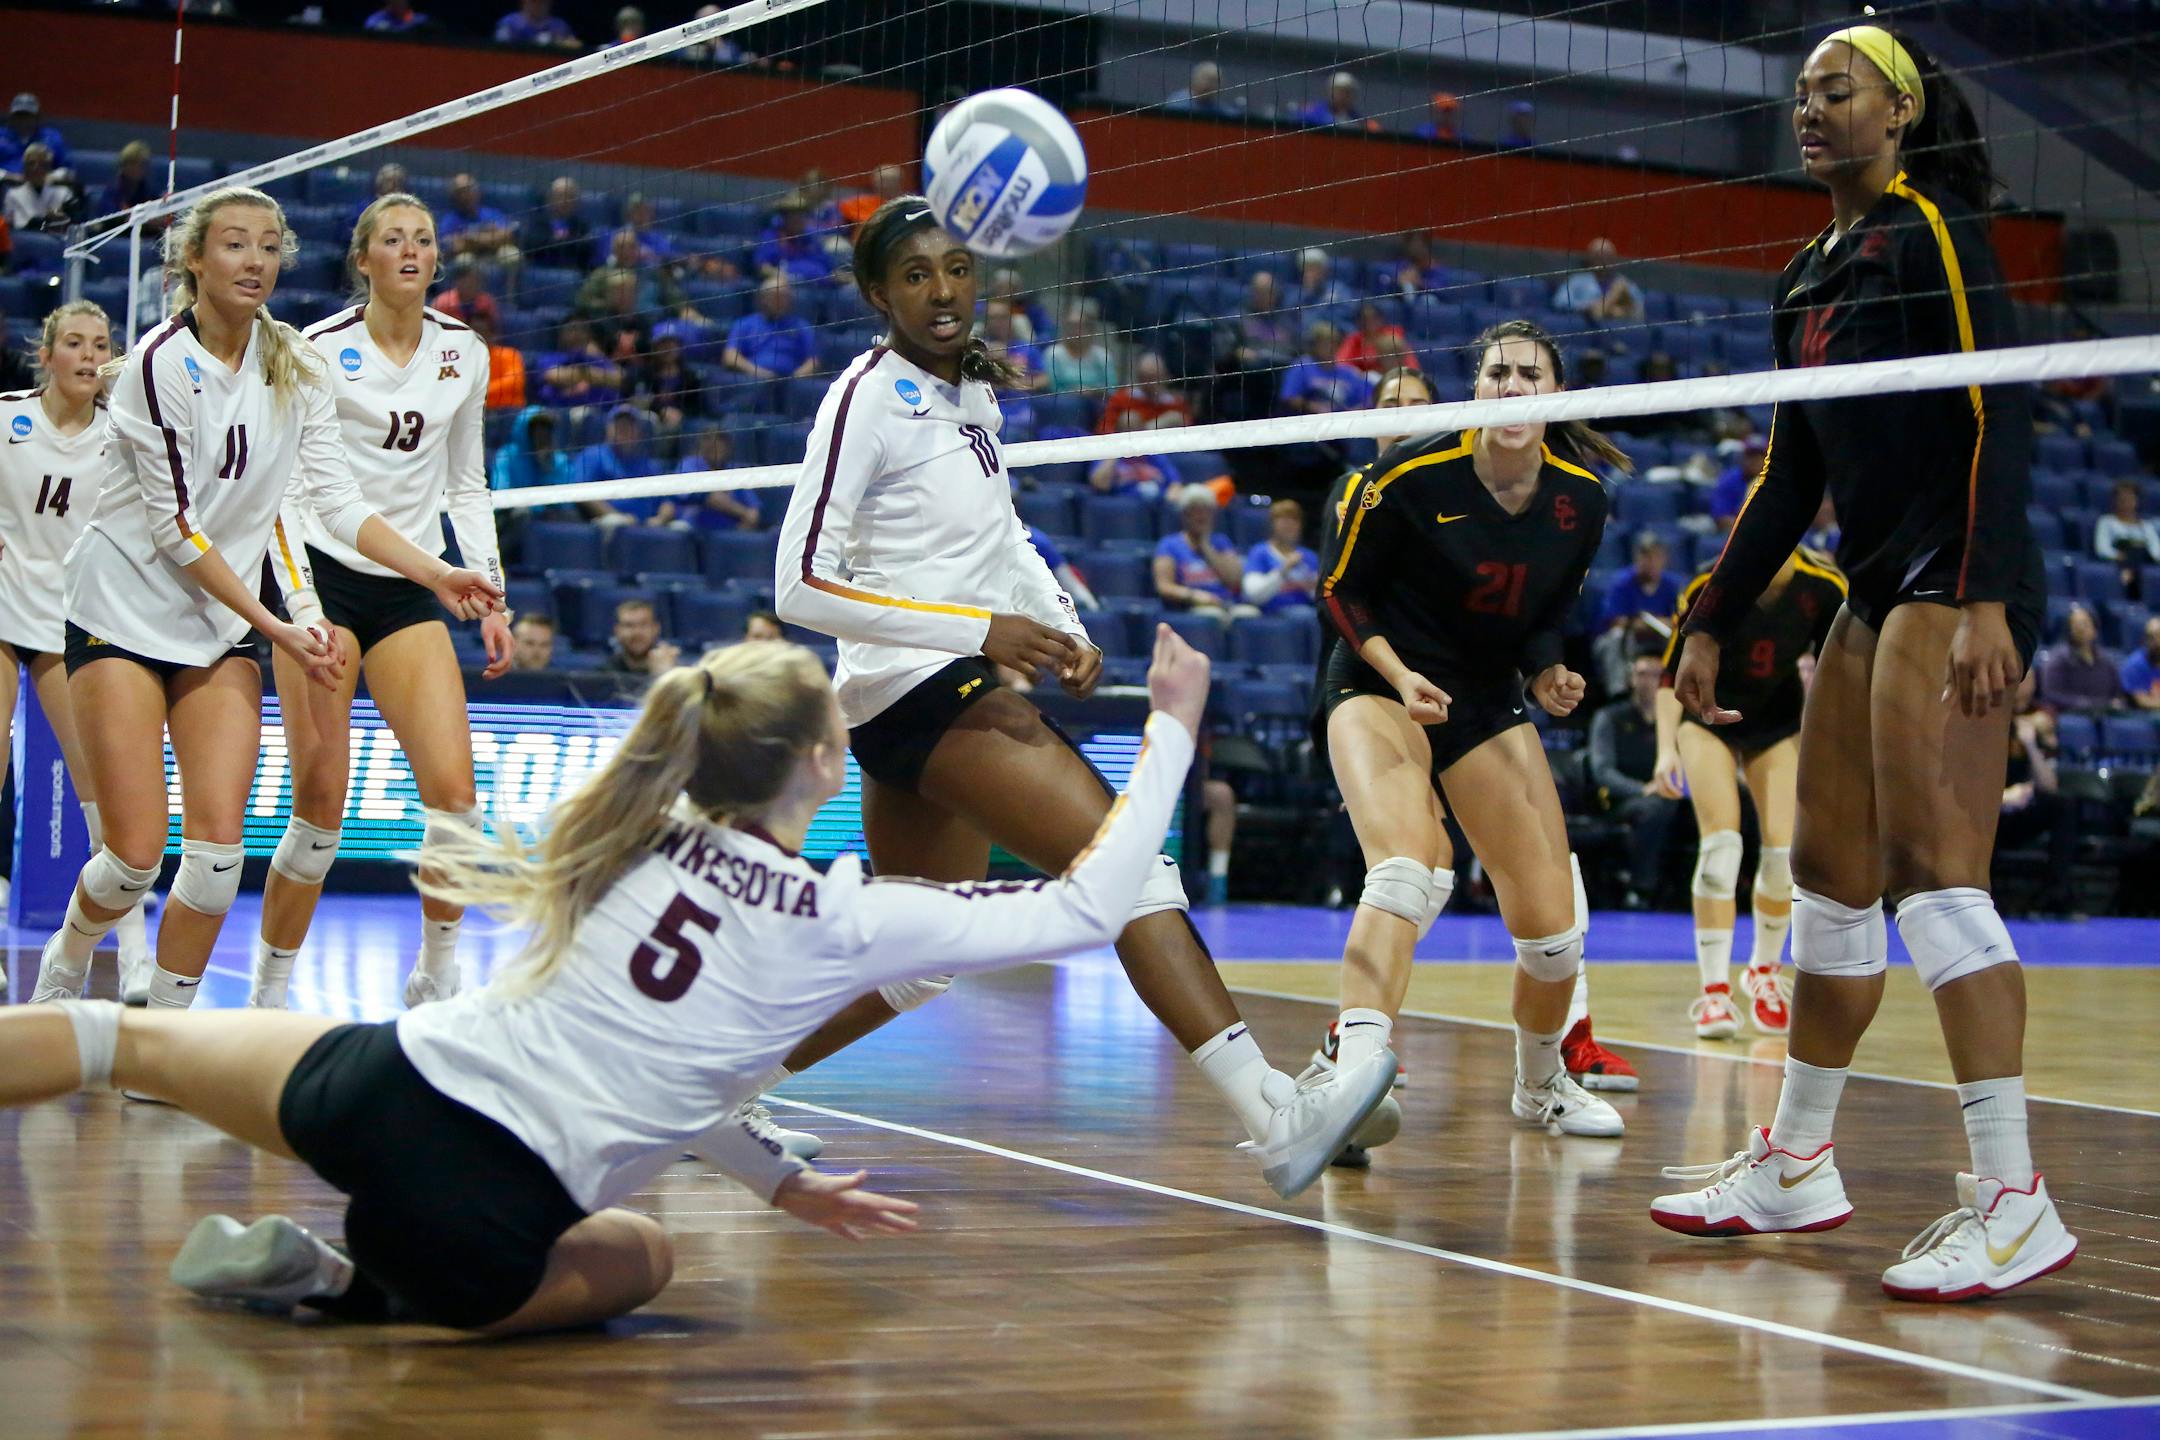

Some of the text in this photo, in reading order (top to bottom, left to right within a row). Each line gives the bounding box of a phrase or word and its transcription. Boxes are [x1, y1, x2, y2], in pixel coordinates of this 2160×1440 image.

[218, 424, 248, 480] 11
[382, 411, 425, 452] 13
[959, 424, 999, 478] 10
[35, 474, 72, 518] 14
[1464, 561, 1529, 617] 21
[1746, 638, 1776, 678] 9
[628, 891, 722, 1003] 5
